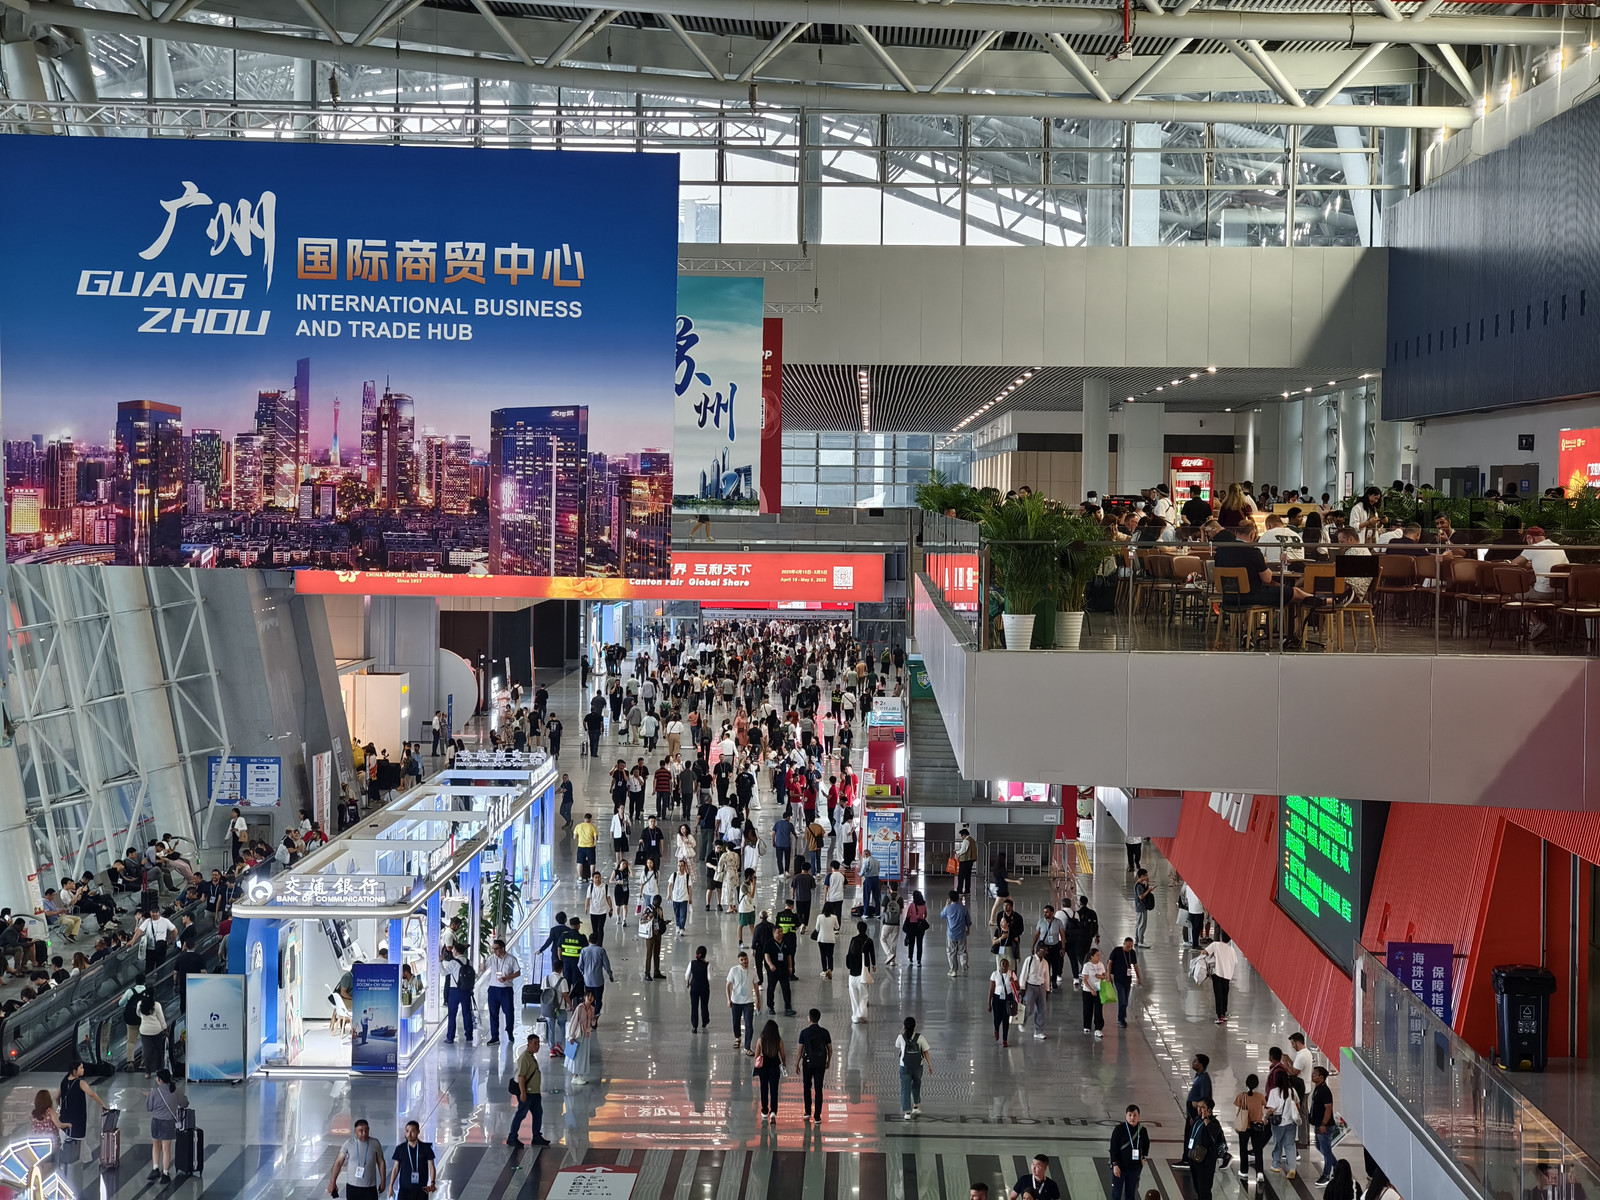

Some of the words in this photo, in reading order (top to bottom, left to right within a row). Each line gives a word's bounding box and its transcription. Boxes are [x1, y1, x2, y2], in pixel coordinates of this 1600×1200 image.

[138, 181, 276, 295] 广州
[297, 237, 585, 288] 国际商贸中心
[76, 270, 248, 300] GUANG
[296, 294, 468, 315] INTERNATIONAL
[474, 299, 583, 318] BUSINESS
[137, 307, 272, 336] ZHOU
[296, 320, 341, 337] AND
[348, 321, 421, 339] TRADE
[428, 323, 473, 341] HUB
[694, 563, 752, 576] 互利天下
[629, 578, 662, 586] Canton
[688, 578, 719, 586] Global
[722, 578, 750, 587] Share
[276, 895, 299, 903] BANK
[302, 895, 312, 903] OF
[316, 895, 386, 903] COMMUNICATIONS
